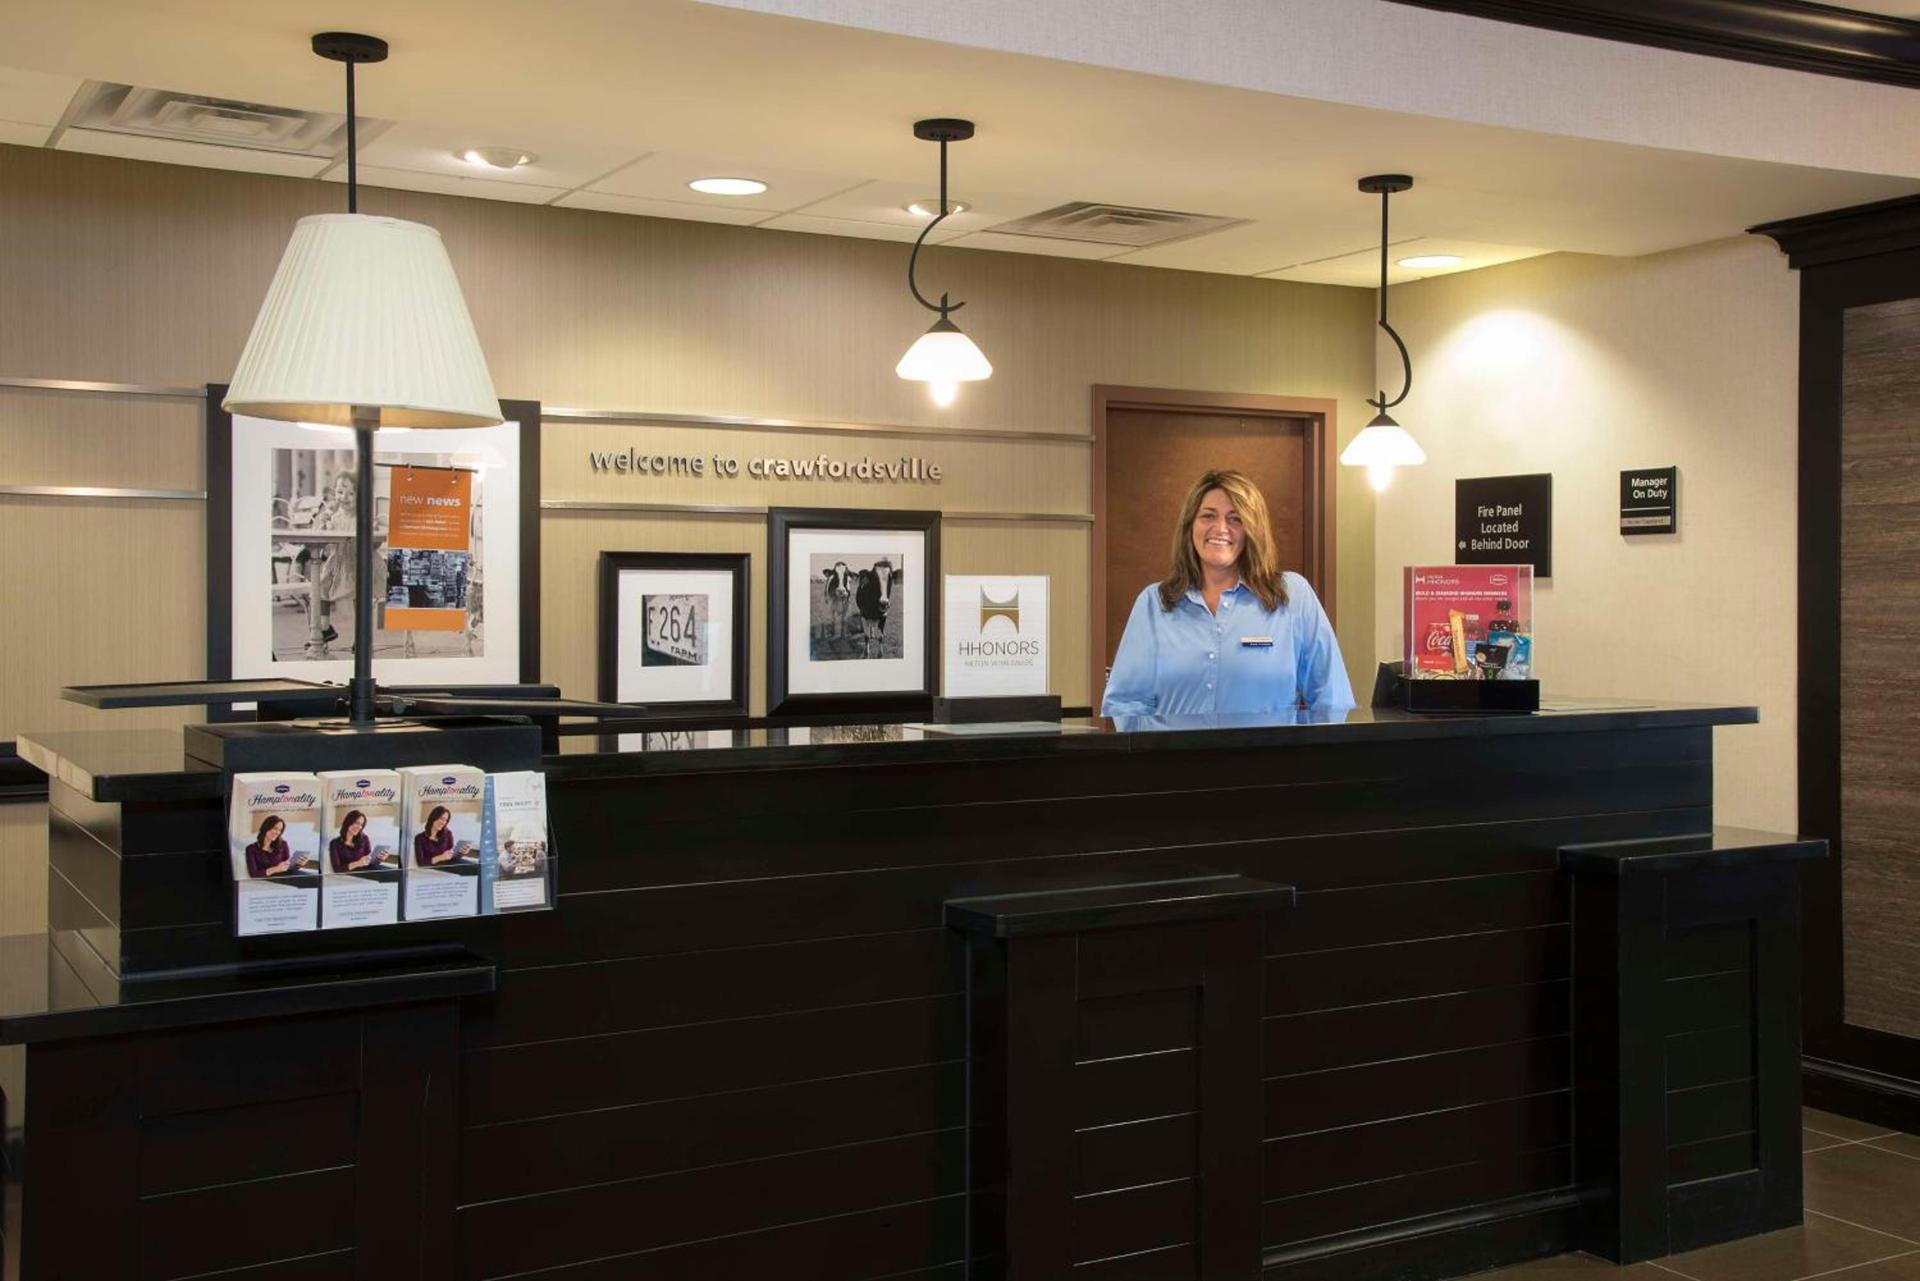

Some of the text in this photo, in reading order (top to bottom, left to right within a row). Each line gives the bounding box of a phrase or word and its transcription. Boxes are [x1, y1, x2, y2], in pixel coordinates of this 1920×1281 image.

[591, 448, 943, 482] welcome to crawfordsville
[1631, 478, 1668, 489] Manager
[400, 495, 461, 507] new news
[1632, 489, 1668, 500] On Duty
[1477, 503, 1522, 518] Fire Panel
[1480, 520, 1519, 534] Located
[1471, 537, 1530, 551] Behind Door
[959, 640, 1040, 657] HHONORS
[248, 793, 316, 807] Hamptonality
